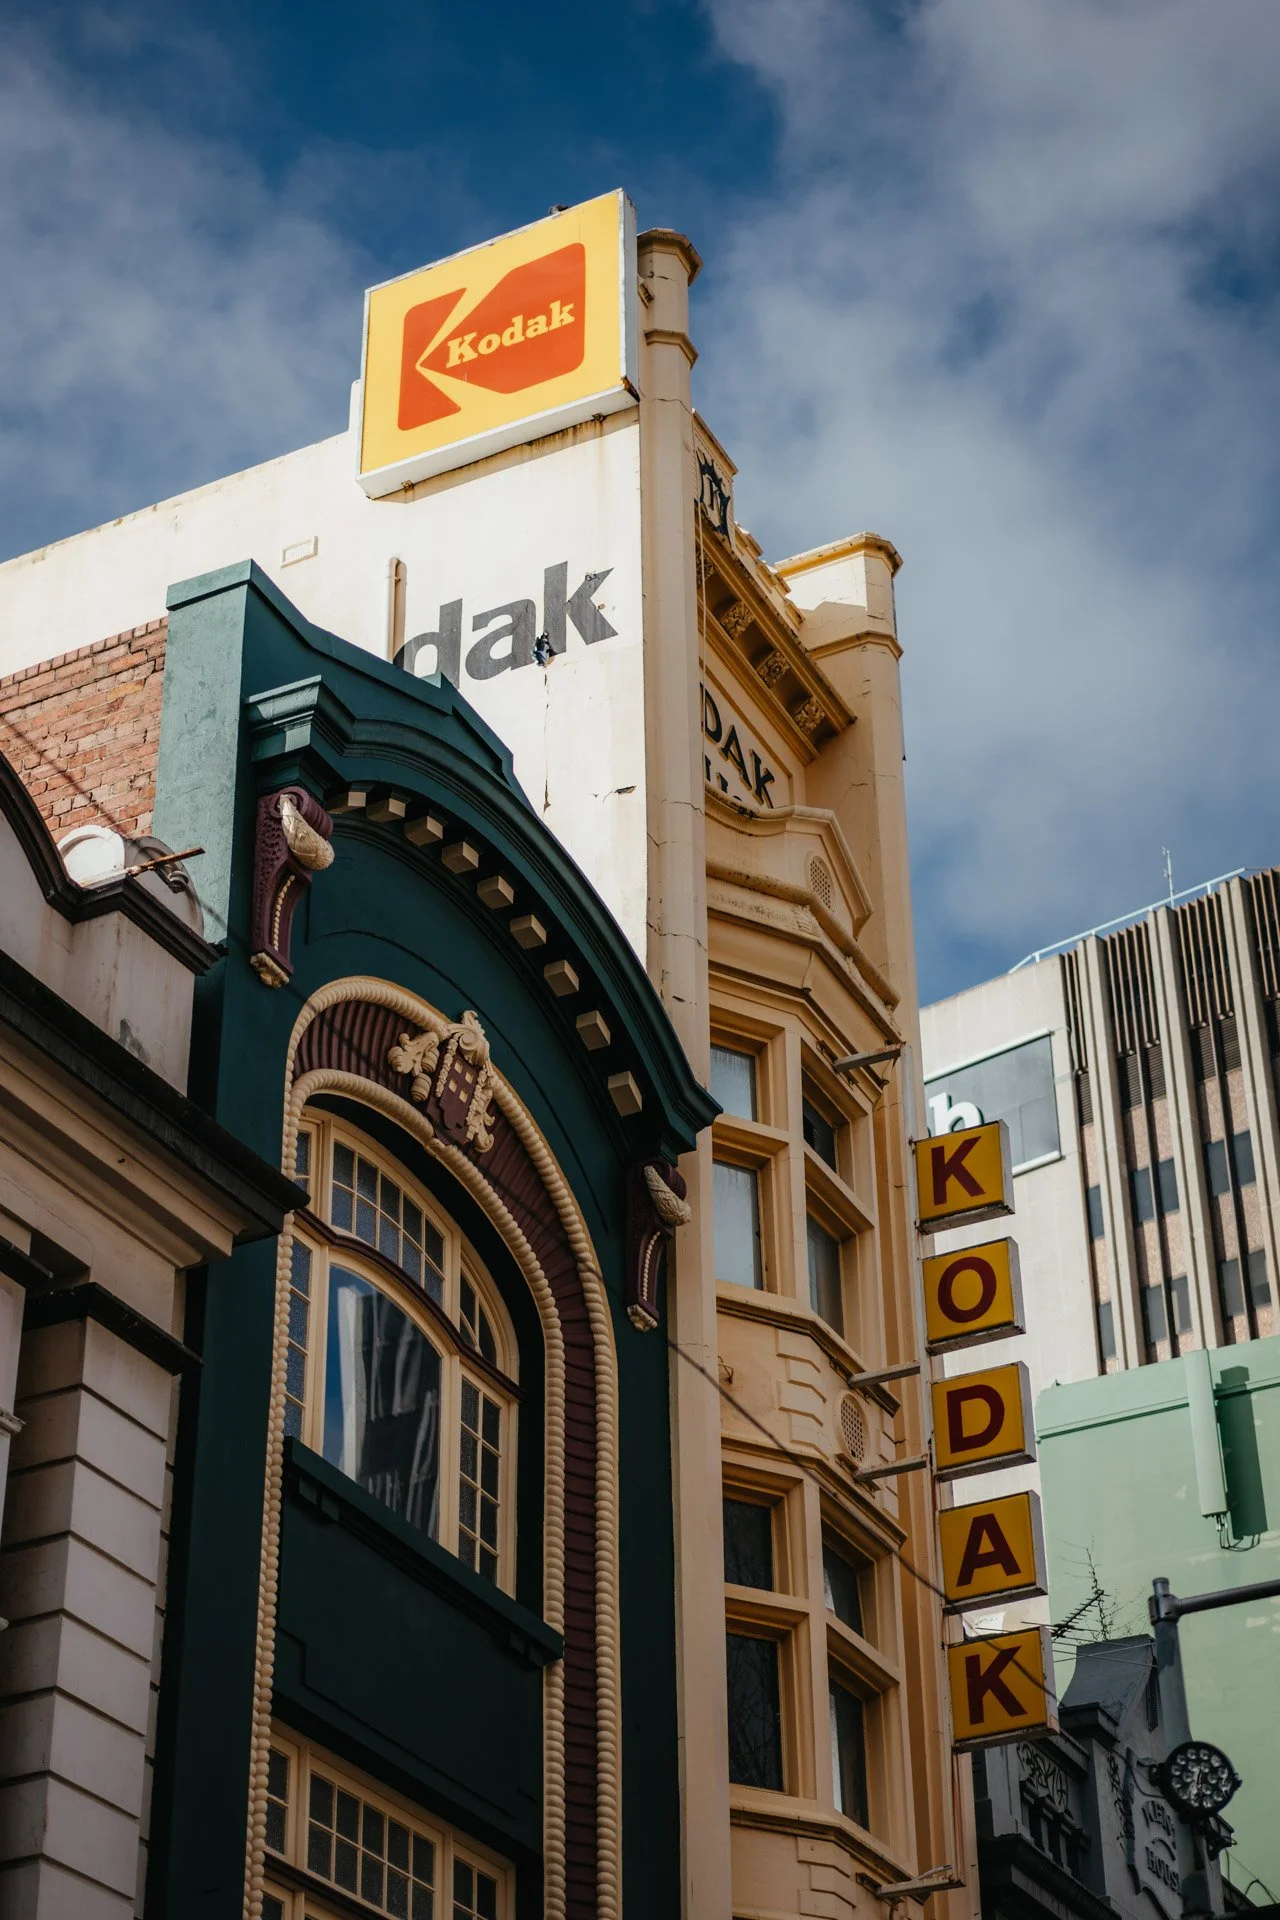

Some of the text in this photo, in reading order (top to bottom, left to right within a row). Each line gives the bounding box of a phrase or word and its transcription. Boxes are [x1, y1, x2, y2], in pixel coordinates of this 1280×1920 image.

[446, 300, 576, 369] Kodak
[393, 561, 619, 689] dak
[931, 1135, 1027, 1725] KODAK
[1145, 1846, 1182, 1896] HOUS
